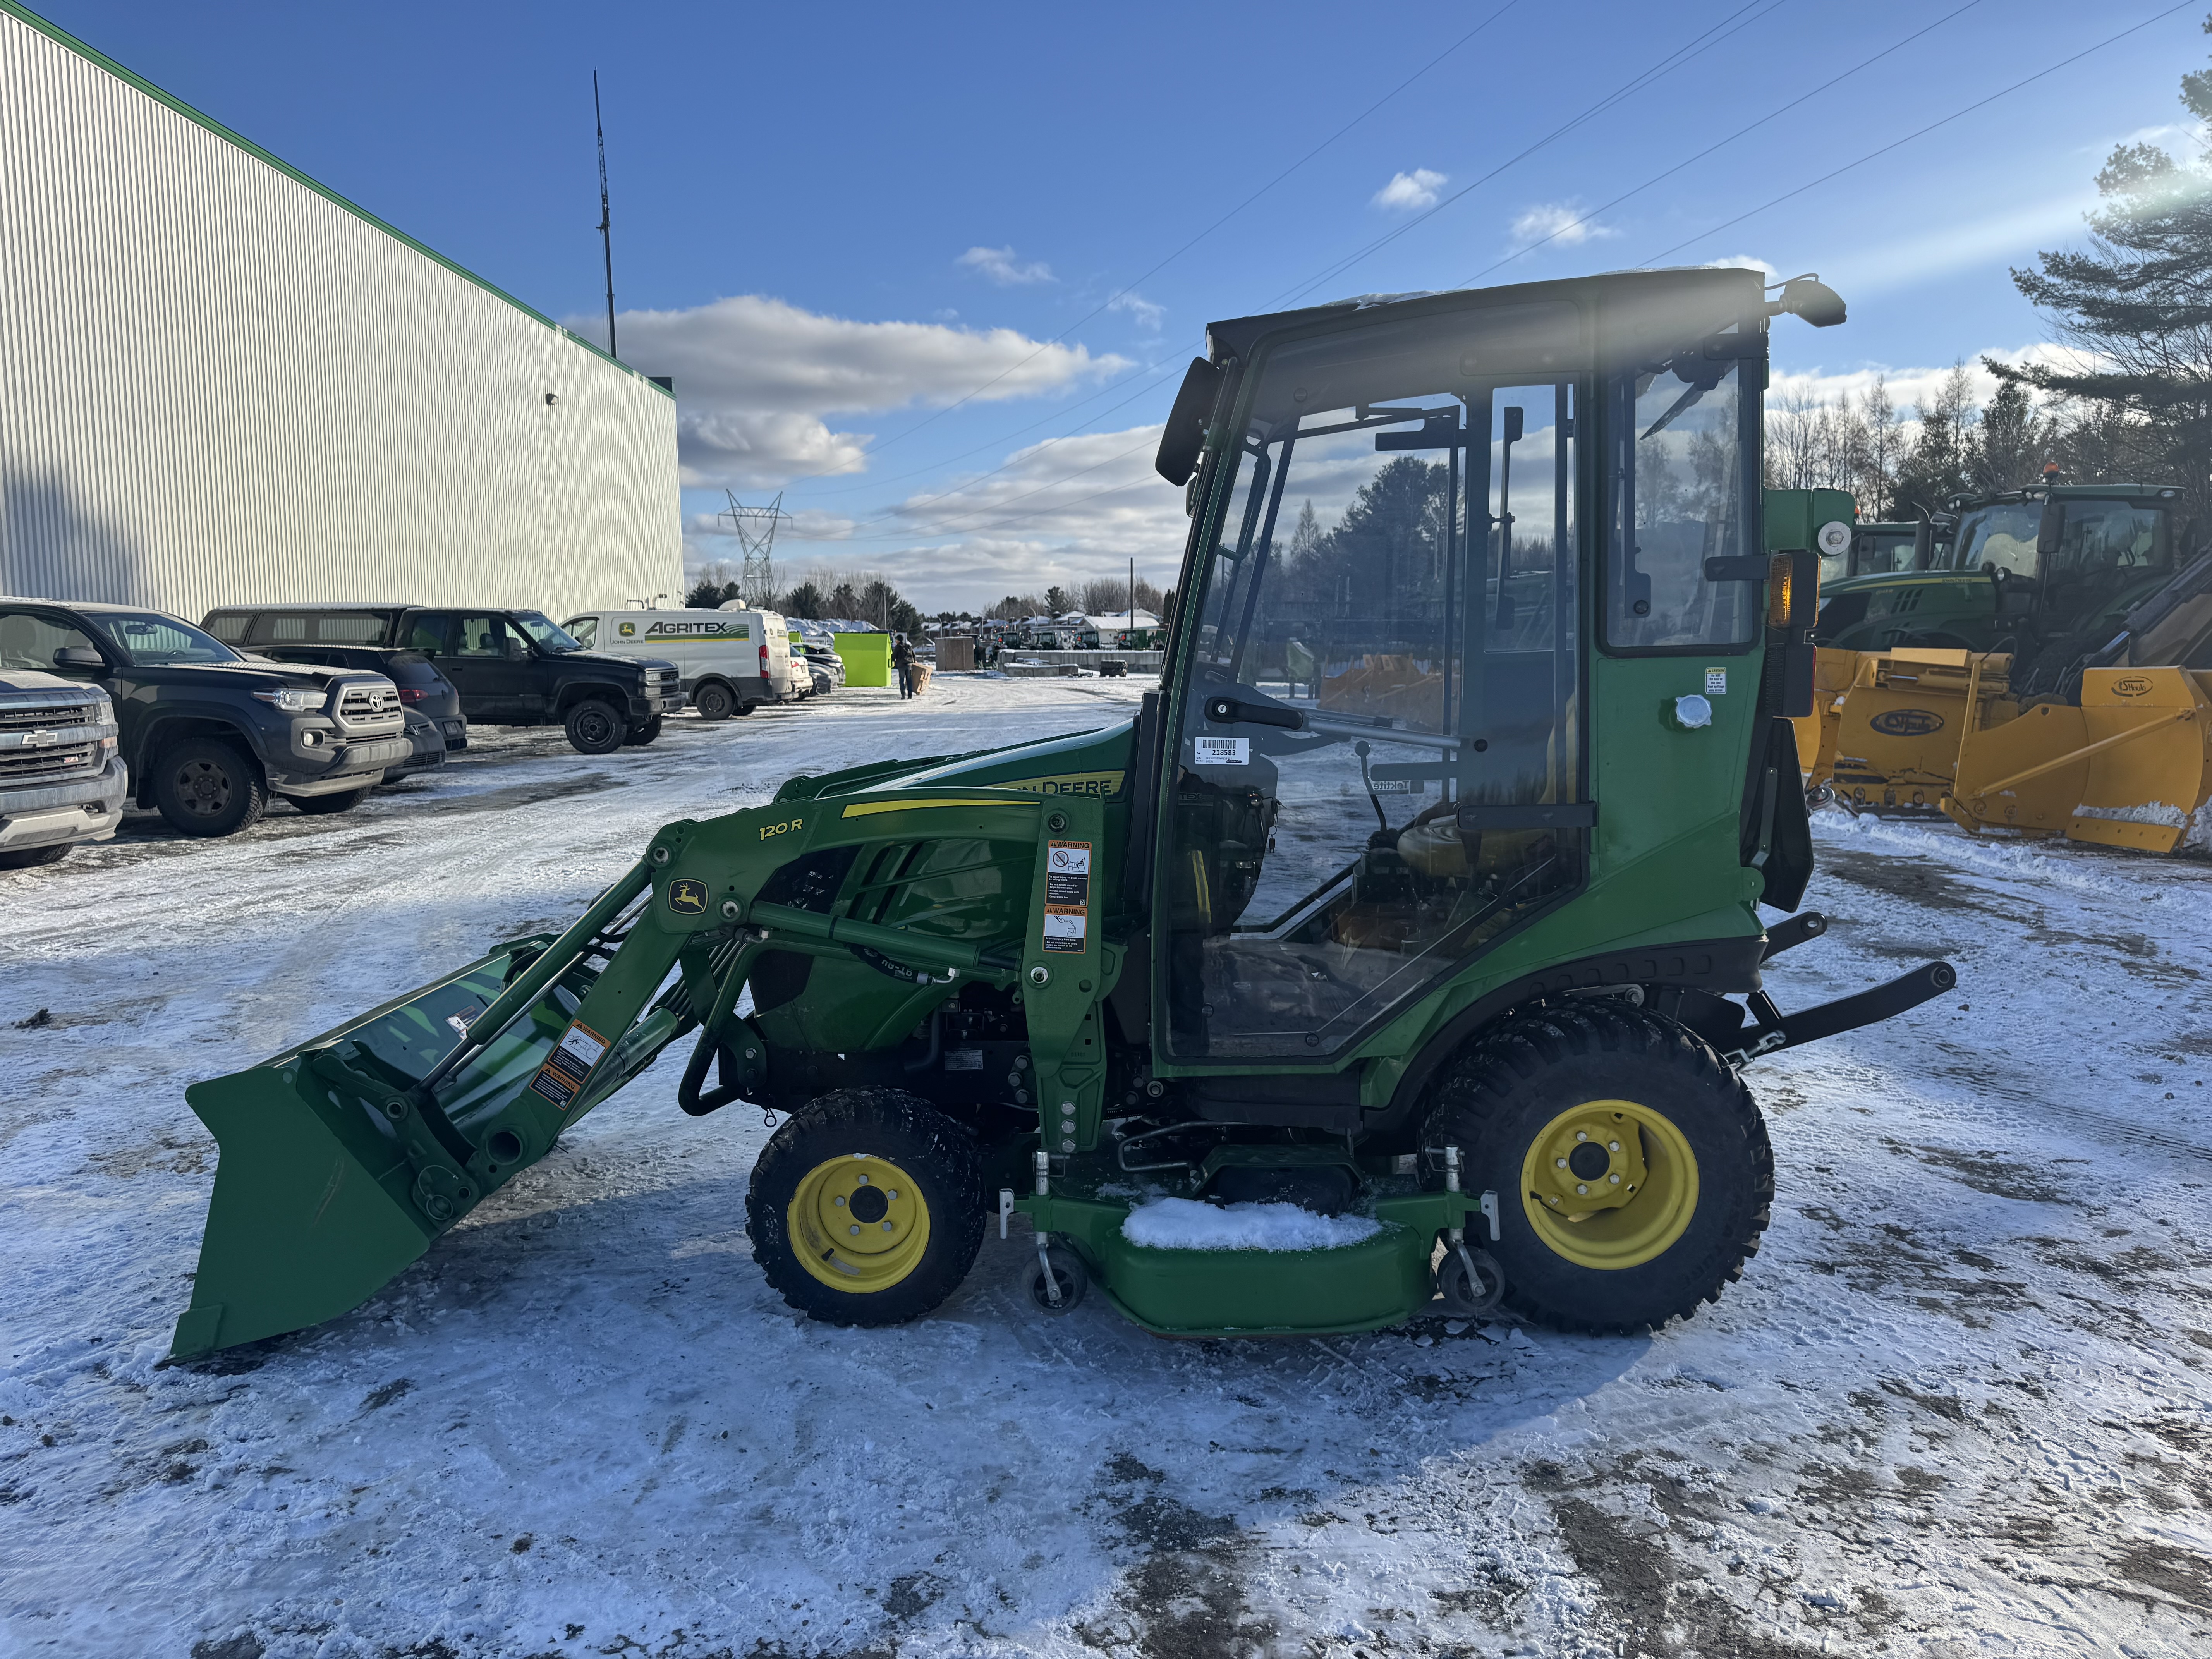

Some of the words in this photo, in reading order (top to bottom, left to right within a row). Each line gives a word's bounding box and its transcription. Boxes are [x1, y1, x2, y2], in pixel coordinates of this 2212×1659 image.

[645, 621, 727, 634] AGRITEX
[1042, 780, 1112, 794] DEERE
[759, 823, 788, 841] 120
[791, 818, 803, 831] R
[583, 1026, 606, 1044] WARNING
[552, 1072, 575, 1089] WARNING
